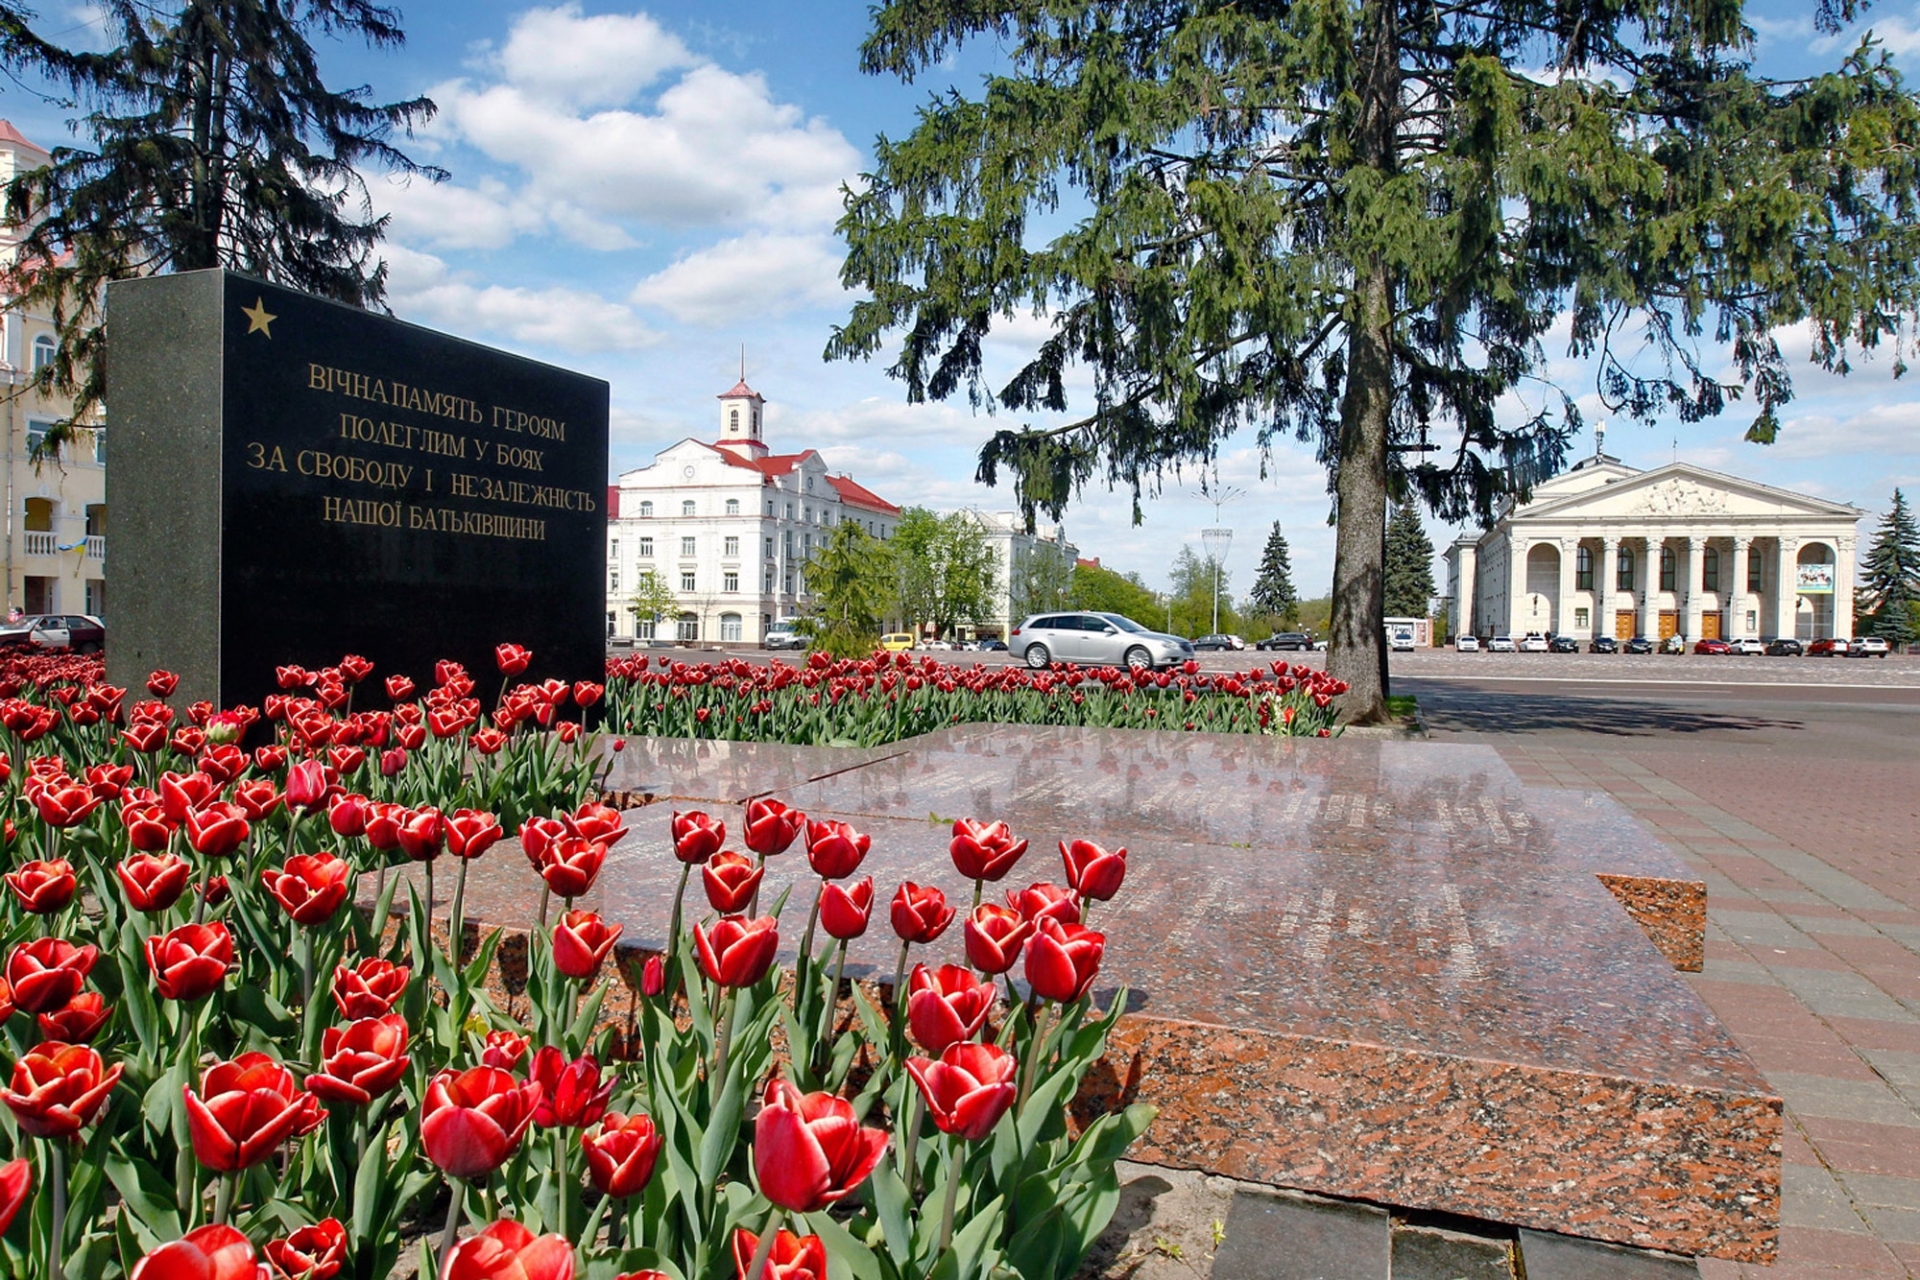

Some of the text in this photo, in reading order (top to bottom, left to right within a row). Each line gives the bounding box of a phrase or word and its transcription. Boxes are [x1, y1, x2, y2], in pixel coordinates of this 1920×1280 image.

[308, 362, 389, 404] ВІЧНА
[493, 406, 566, 442] ГЕРОЯМ
[340, 413, 544, 471] ПОЛЕГЛИМ У БОЯХ
[246, 442, 596, 512] ЗА СВОБОДУ І НЕЗАЛЕЖНІСТЬ
[322, 496, 546, 541] НАШОЇ БАТЬКІВЩИНИ
